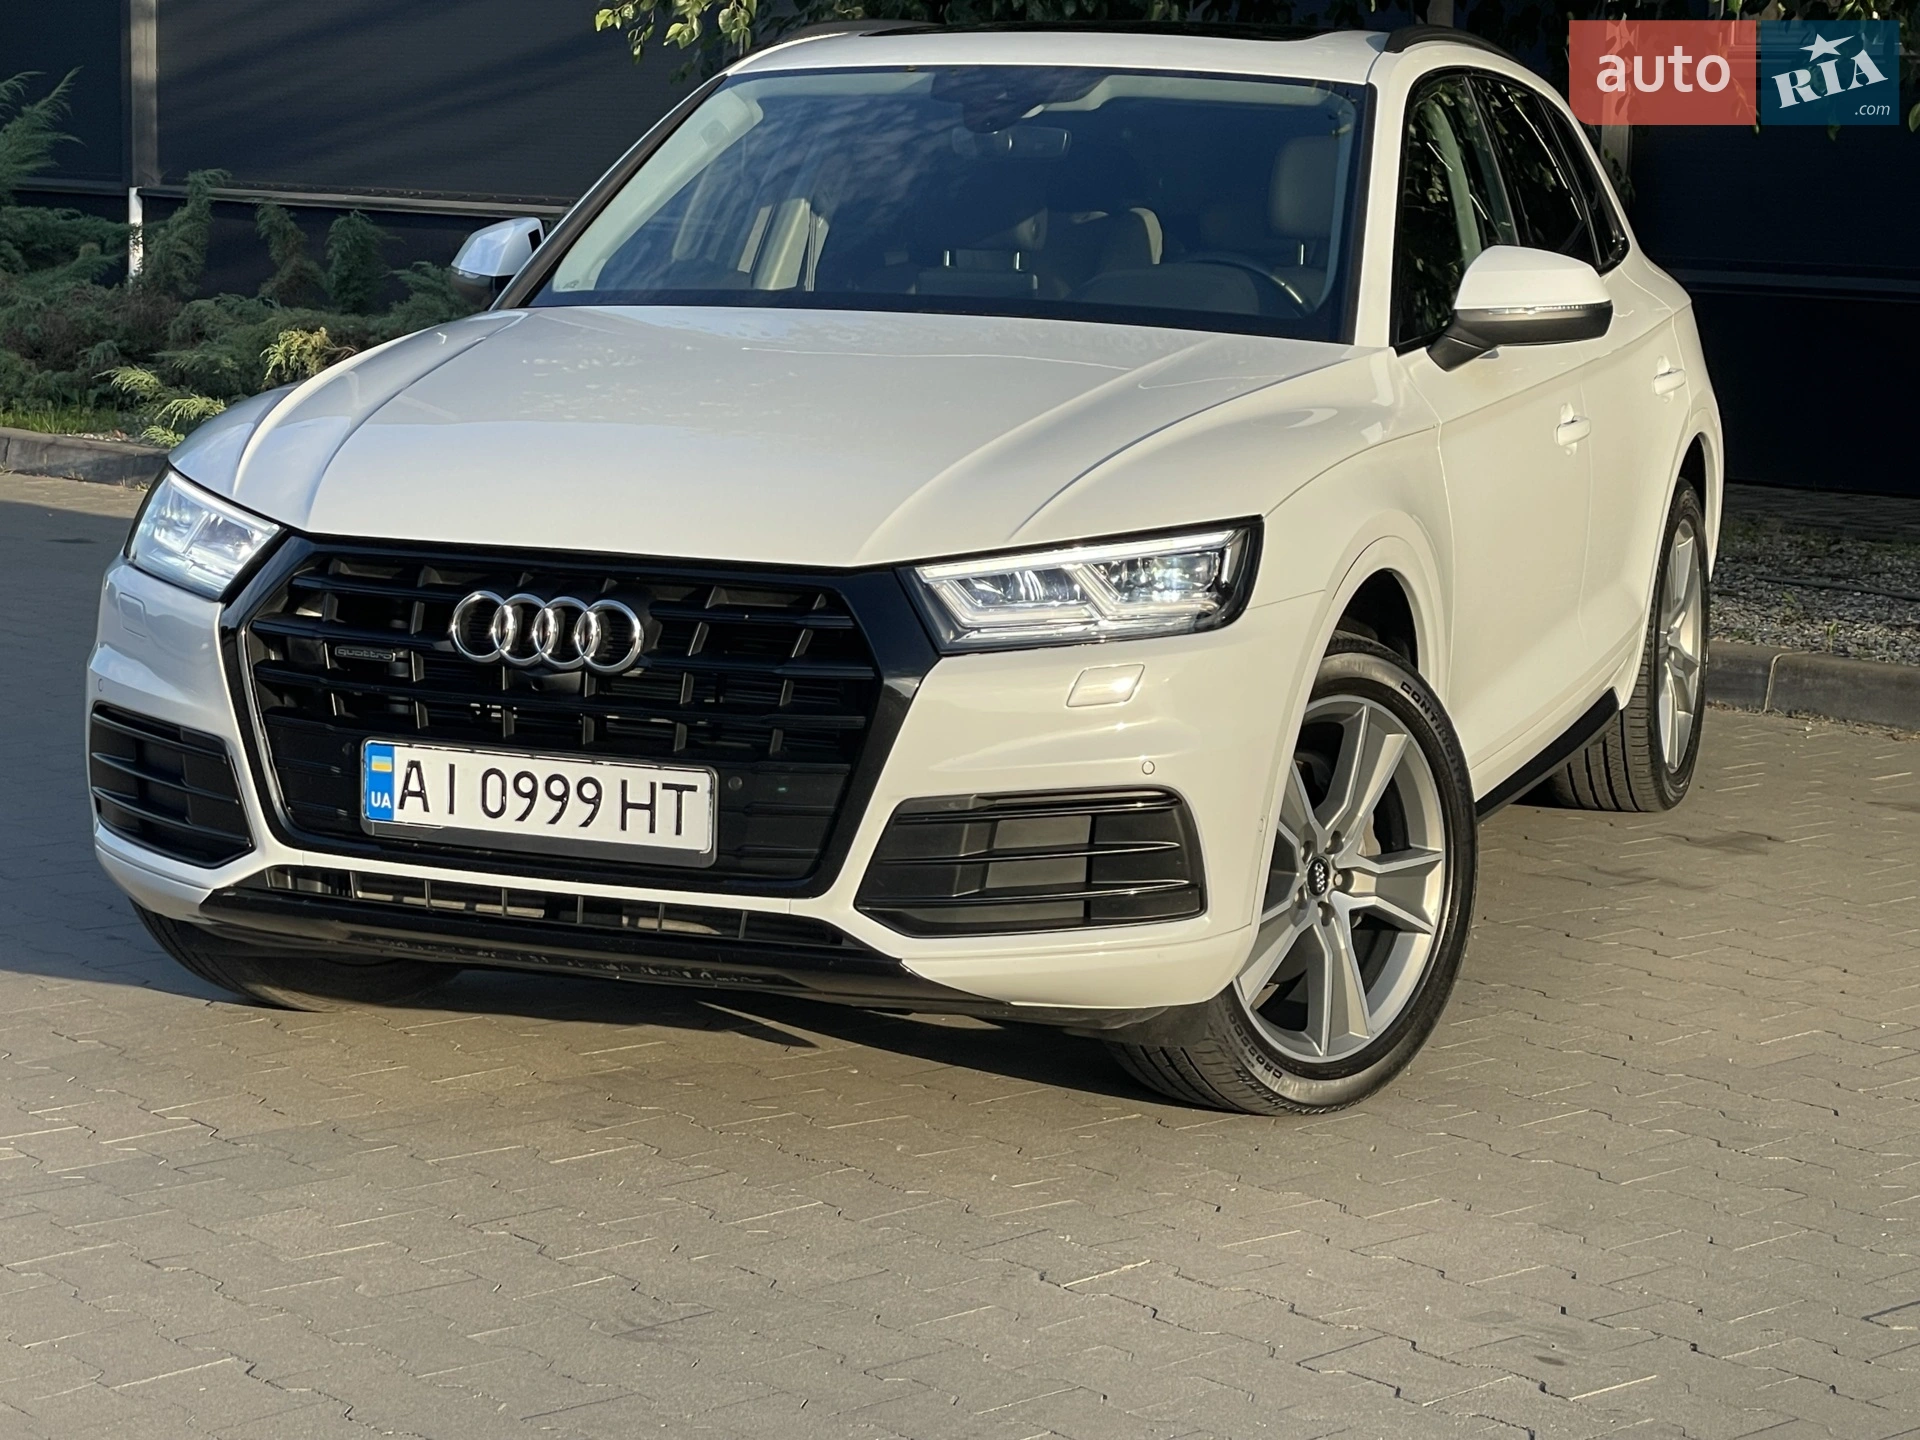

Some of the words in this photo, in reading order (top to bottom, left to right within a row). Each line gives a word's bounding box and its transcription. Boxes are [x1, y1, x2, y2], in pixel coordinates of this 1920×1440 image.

[336, 648, 393, 660] quattro
[371, 790, 391, 809] UA
[480, 767, 602, 828] 0999
[619, 779, 698, 836] HT
